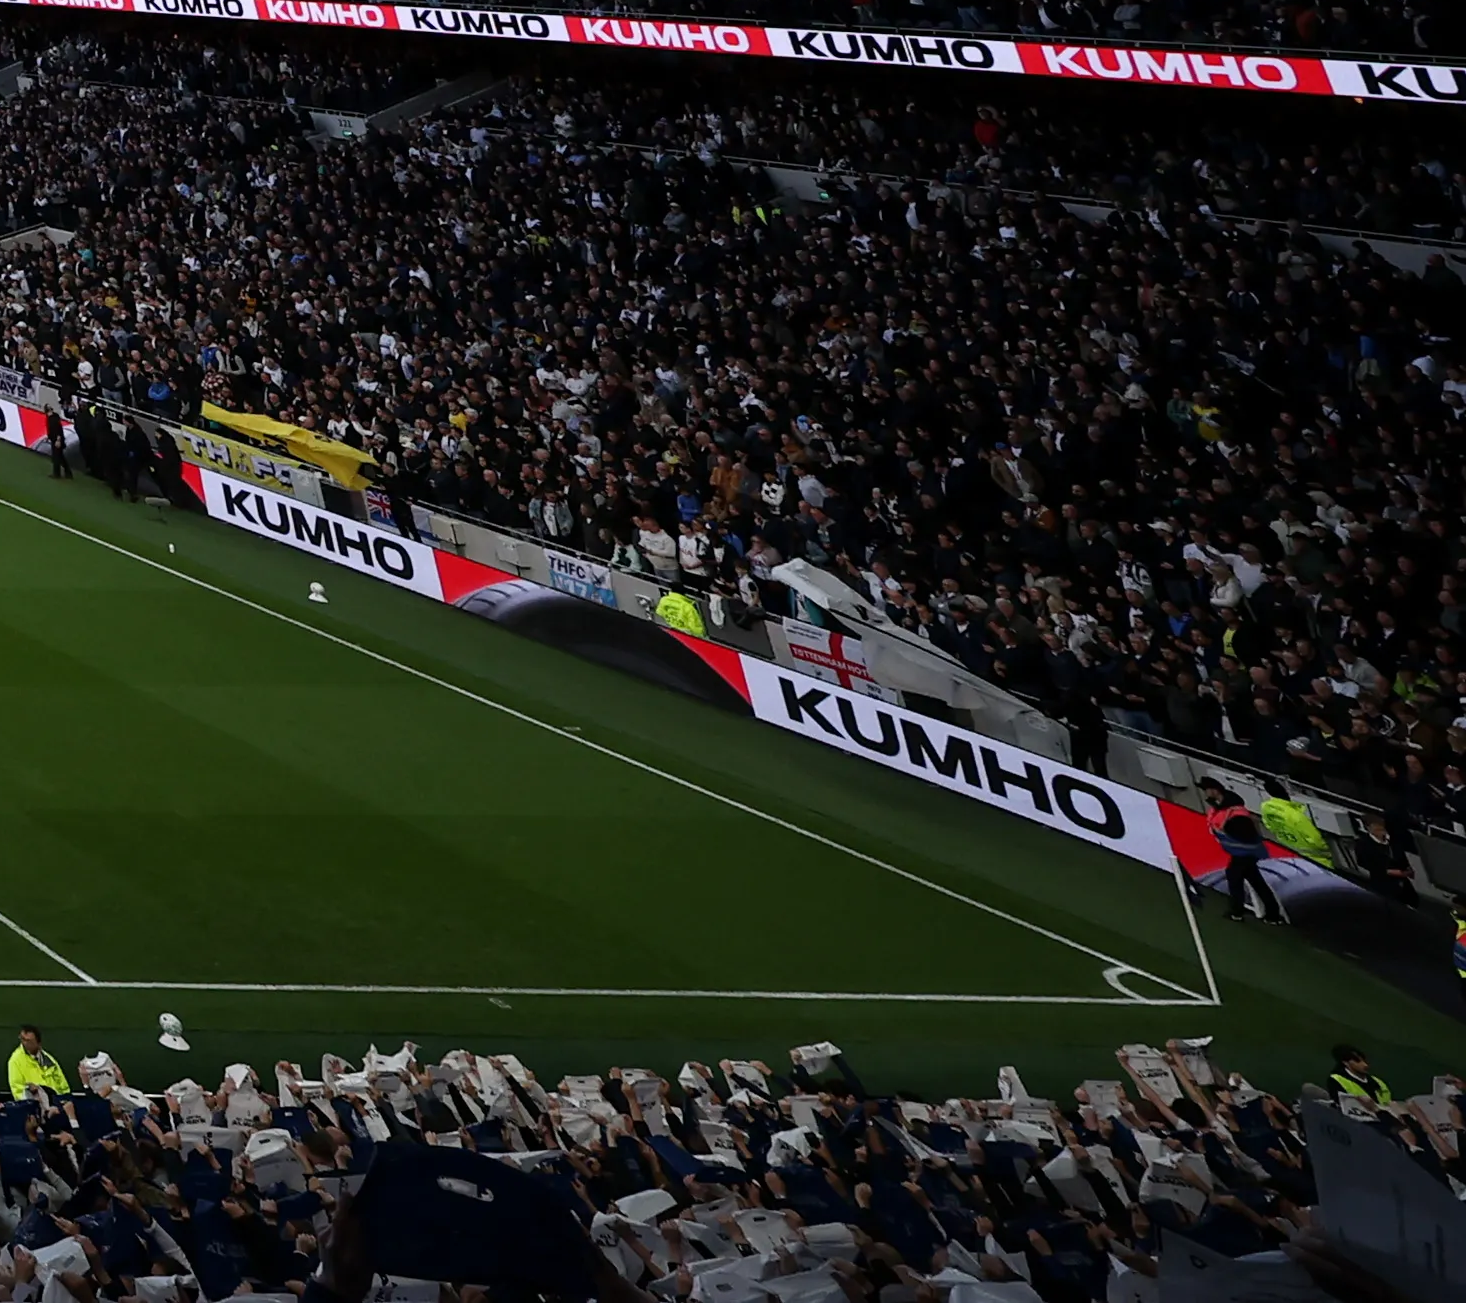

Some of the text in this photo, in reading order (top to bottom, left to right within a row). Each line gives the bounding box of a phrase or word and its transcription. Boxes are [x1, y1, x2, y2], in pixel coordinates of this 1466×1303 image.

[265, 0, 385, 27] KUMHO
[411, 8, 550, 39] KUMHO
[581, 18, 750, 53] KUMHO
[788, 30, 994, 70] KUMHO
[1041, 46, 1297, 90] KUMHO
[221, 481, 415, 582] KUMHO
[548, 555, 587, 579] THFC
[776, 675, 1128, 841] KUMHO
